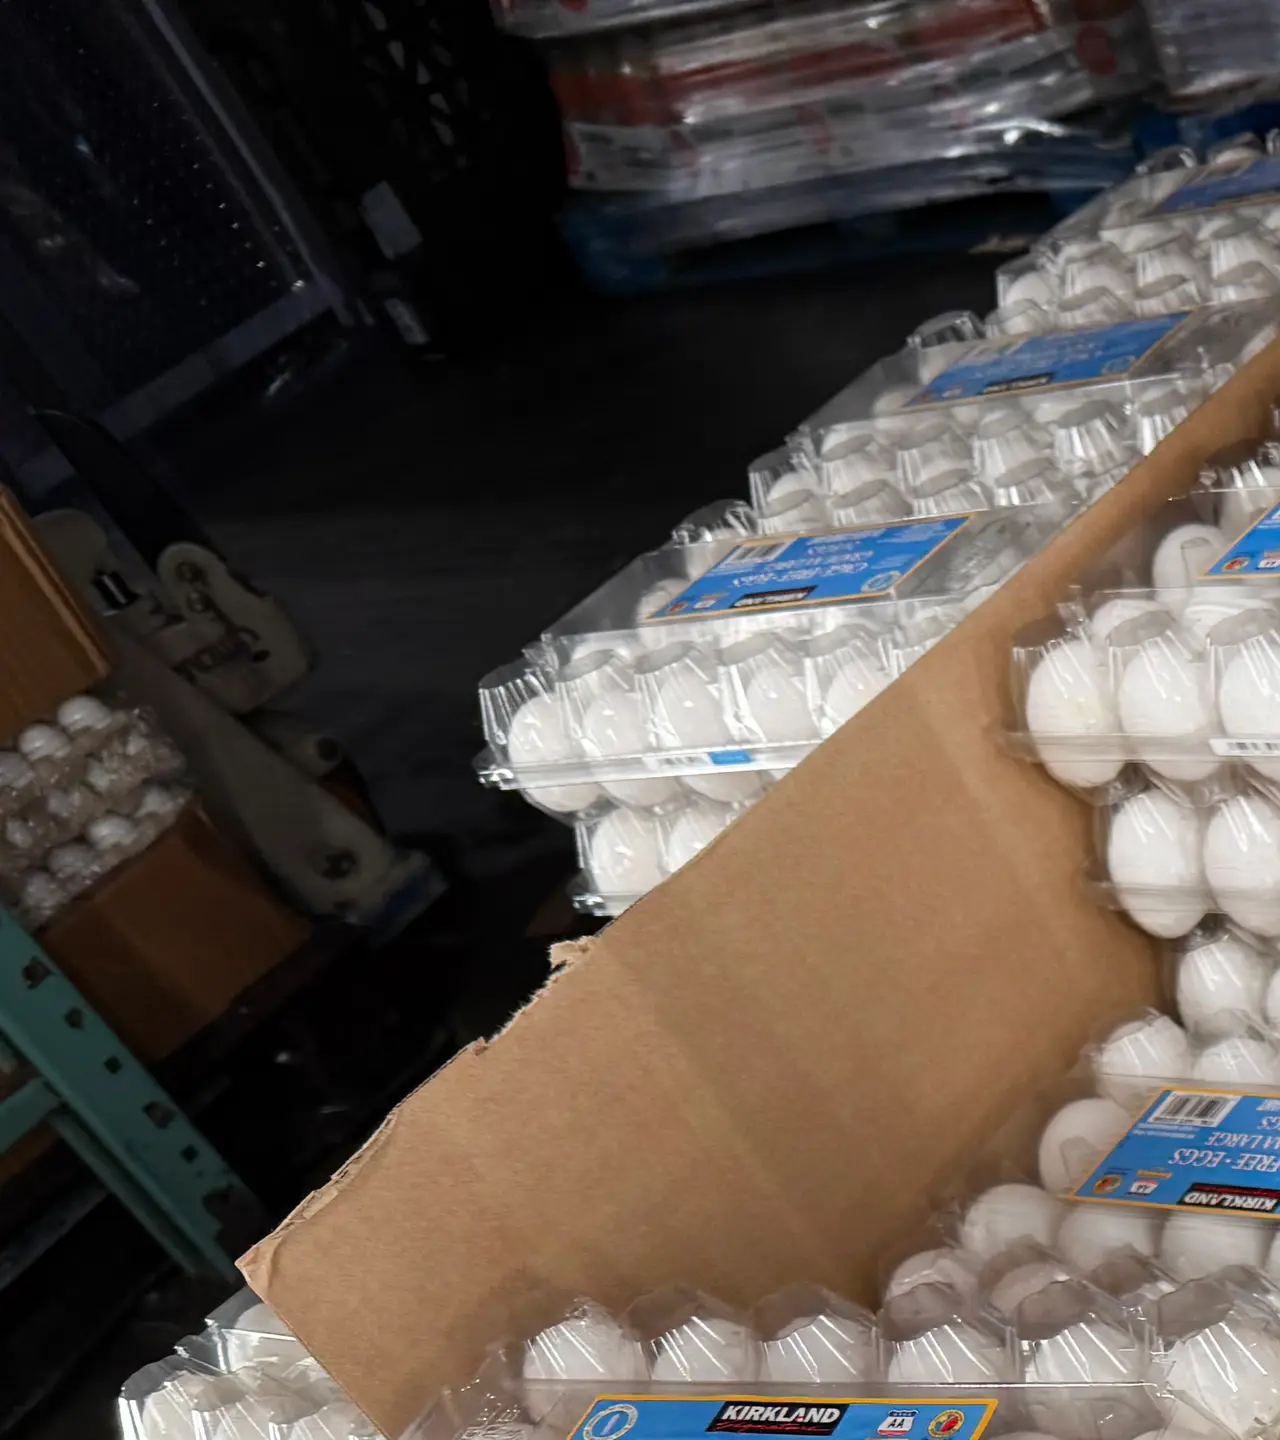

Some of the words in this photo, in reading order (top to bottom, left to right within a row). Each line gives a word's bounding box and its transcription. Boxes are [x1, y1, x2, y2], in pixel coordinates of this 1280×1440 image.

[1205, 1131, 1263, 1149] LARGE
[1168, 1148, 1224, 1167] EGGS
[1183, 1192, 1277, 1210] KIRKLAND
[721, 1406, 841, 1423] KIRKLAND
[888, 1419, 906, 1429] AA
